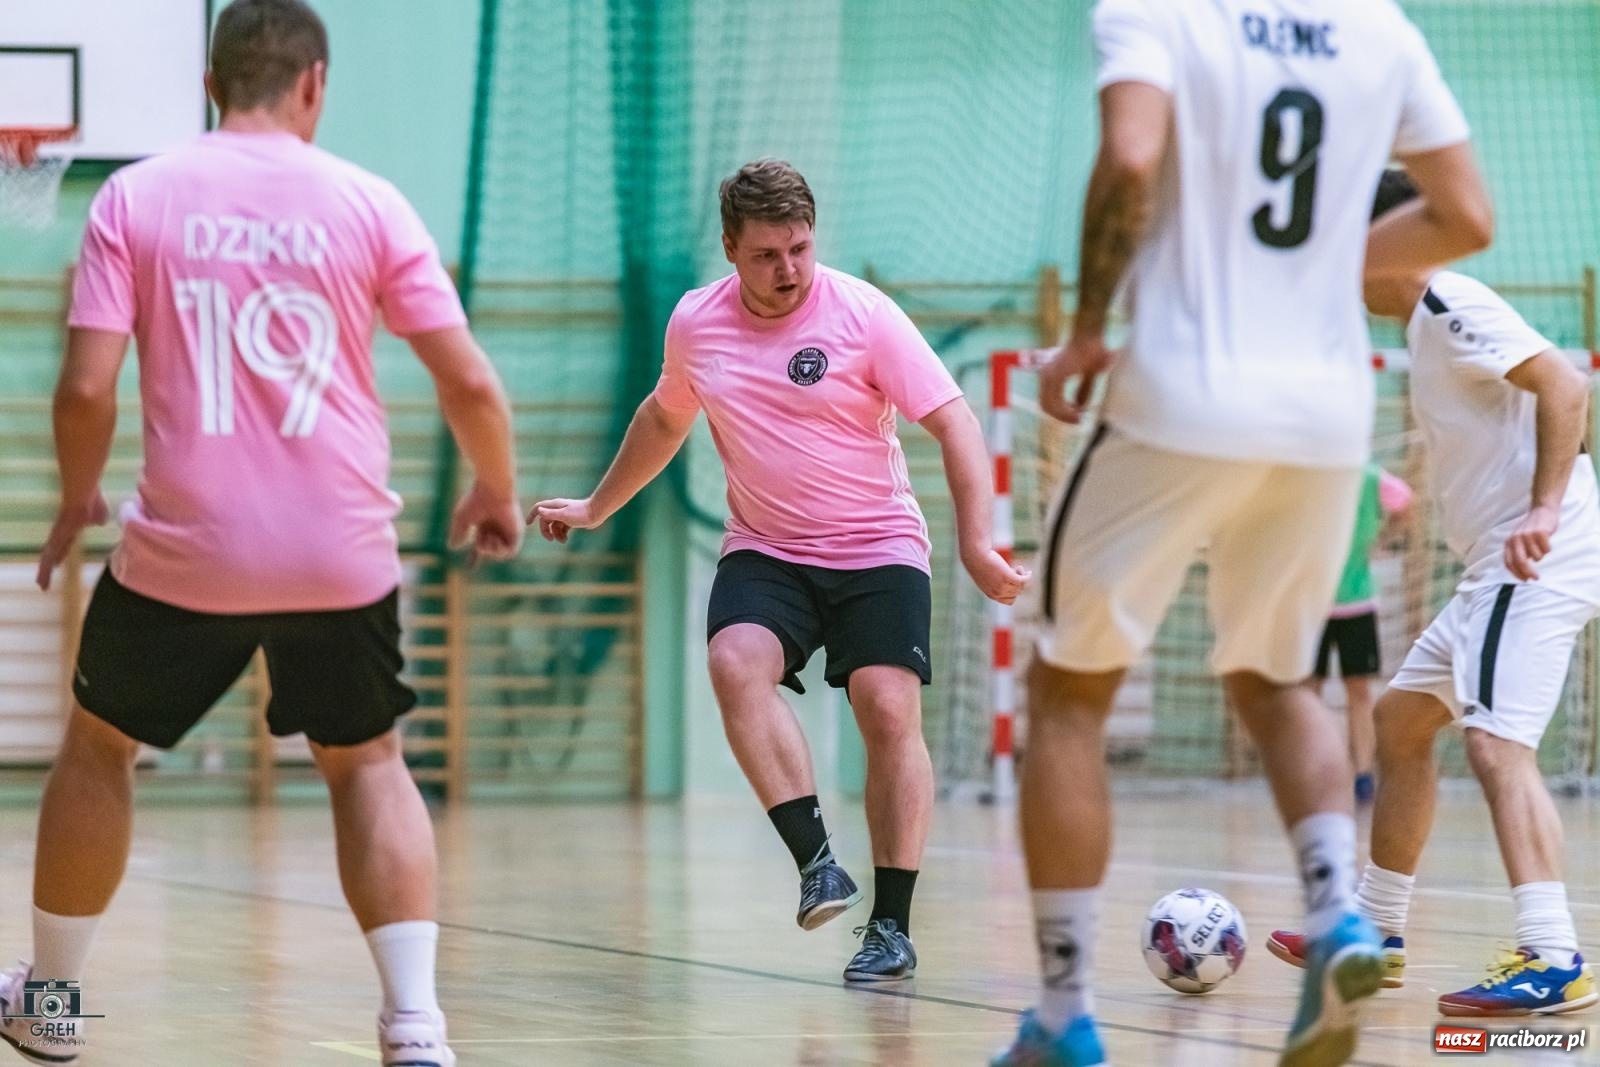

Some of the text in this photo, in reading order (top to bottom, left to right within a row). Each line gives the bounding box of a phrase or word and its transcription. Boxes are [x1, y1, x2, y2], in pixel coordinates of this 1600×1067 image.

[1251, 87, 1324, 248] 9
[175, 278, 339, 437] 19
[1191, 903, 1227, 948] SELECT
